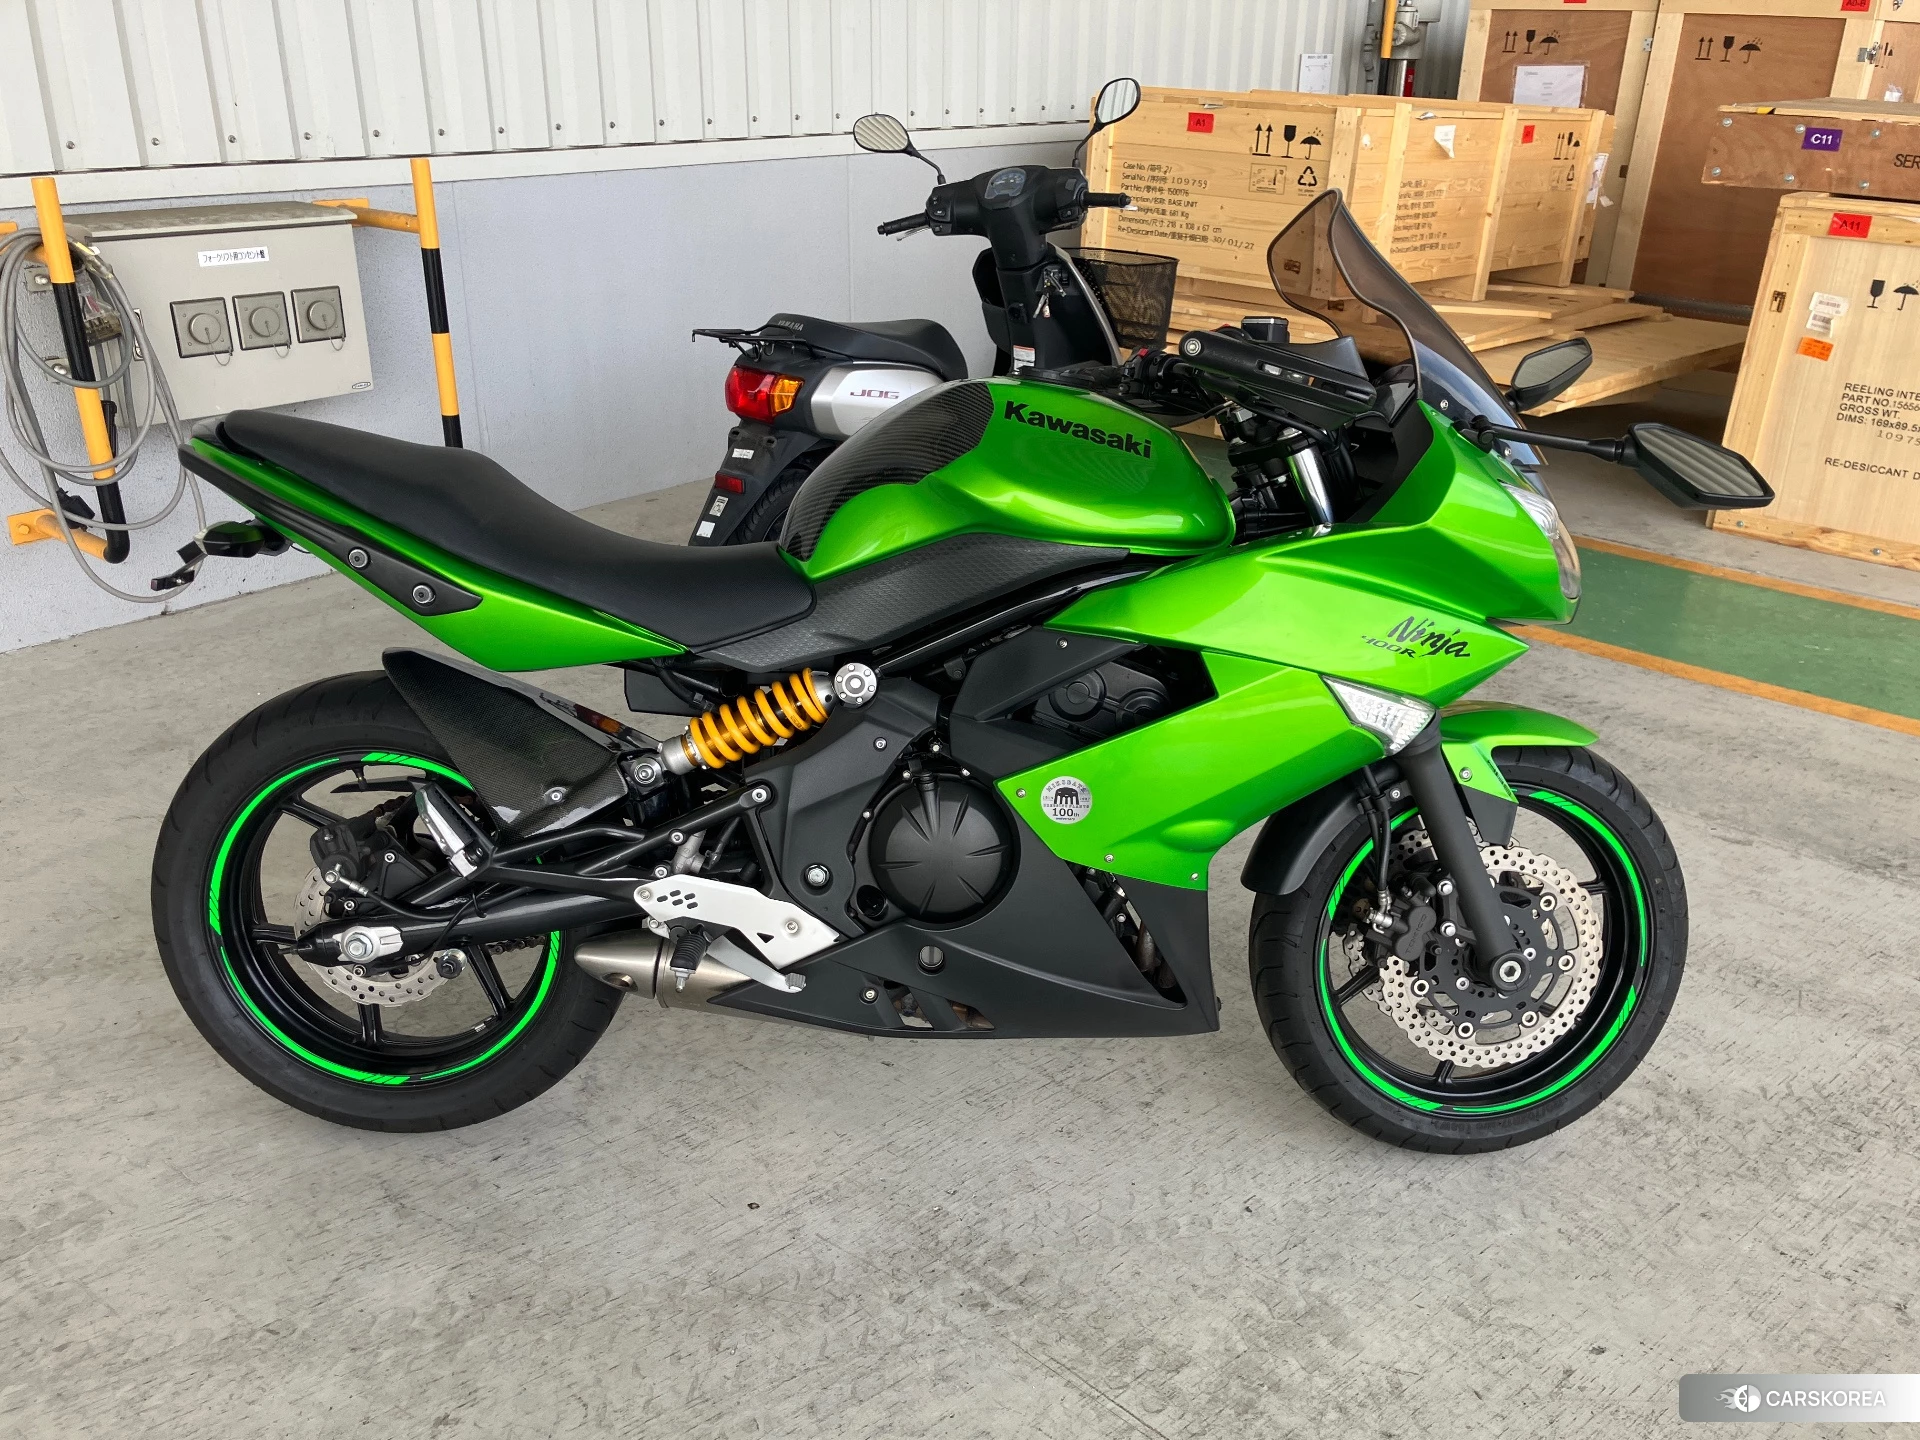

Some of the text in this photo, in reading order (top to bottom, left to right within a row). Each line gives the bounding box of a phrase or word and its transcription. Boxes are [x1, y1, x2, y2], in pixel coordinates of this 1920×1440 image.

[1195, 118, 1206, 127] A1
[1811, 133, 1833, 145] C11
[1122, 161, 1135, 170] Case
[1893, 154, 1920, 169] SER
[1121, 172, 1136, 181] Serial
[1120, 183, 1134, 191] Part
[1168, 198, 1182, 207] BASE
[1184, 200, 1198, 208] UNIT
[1180, 211, 1190, 220] Kg
[1201, 224, 1210, 232] 67
[1839, 219, 1861, 232] A11
[777, 320, 804, 331] YAMAHA
[849, 389, 900, 400] JOG
[1841, 392, 1872, 404] PART
[1844, 382, 1920, 403] REELING INTE
[1839, 402, 1901, 420] GROSS WT.
[1836, 412, 1868, 425] DIMS:
[1004, 400, 1152, 459] Kawasaki
[1824, 456, 1909, 478] RE-DESICCANT
[1387, 616, 1471, 658] Ninja
